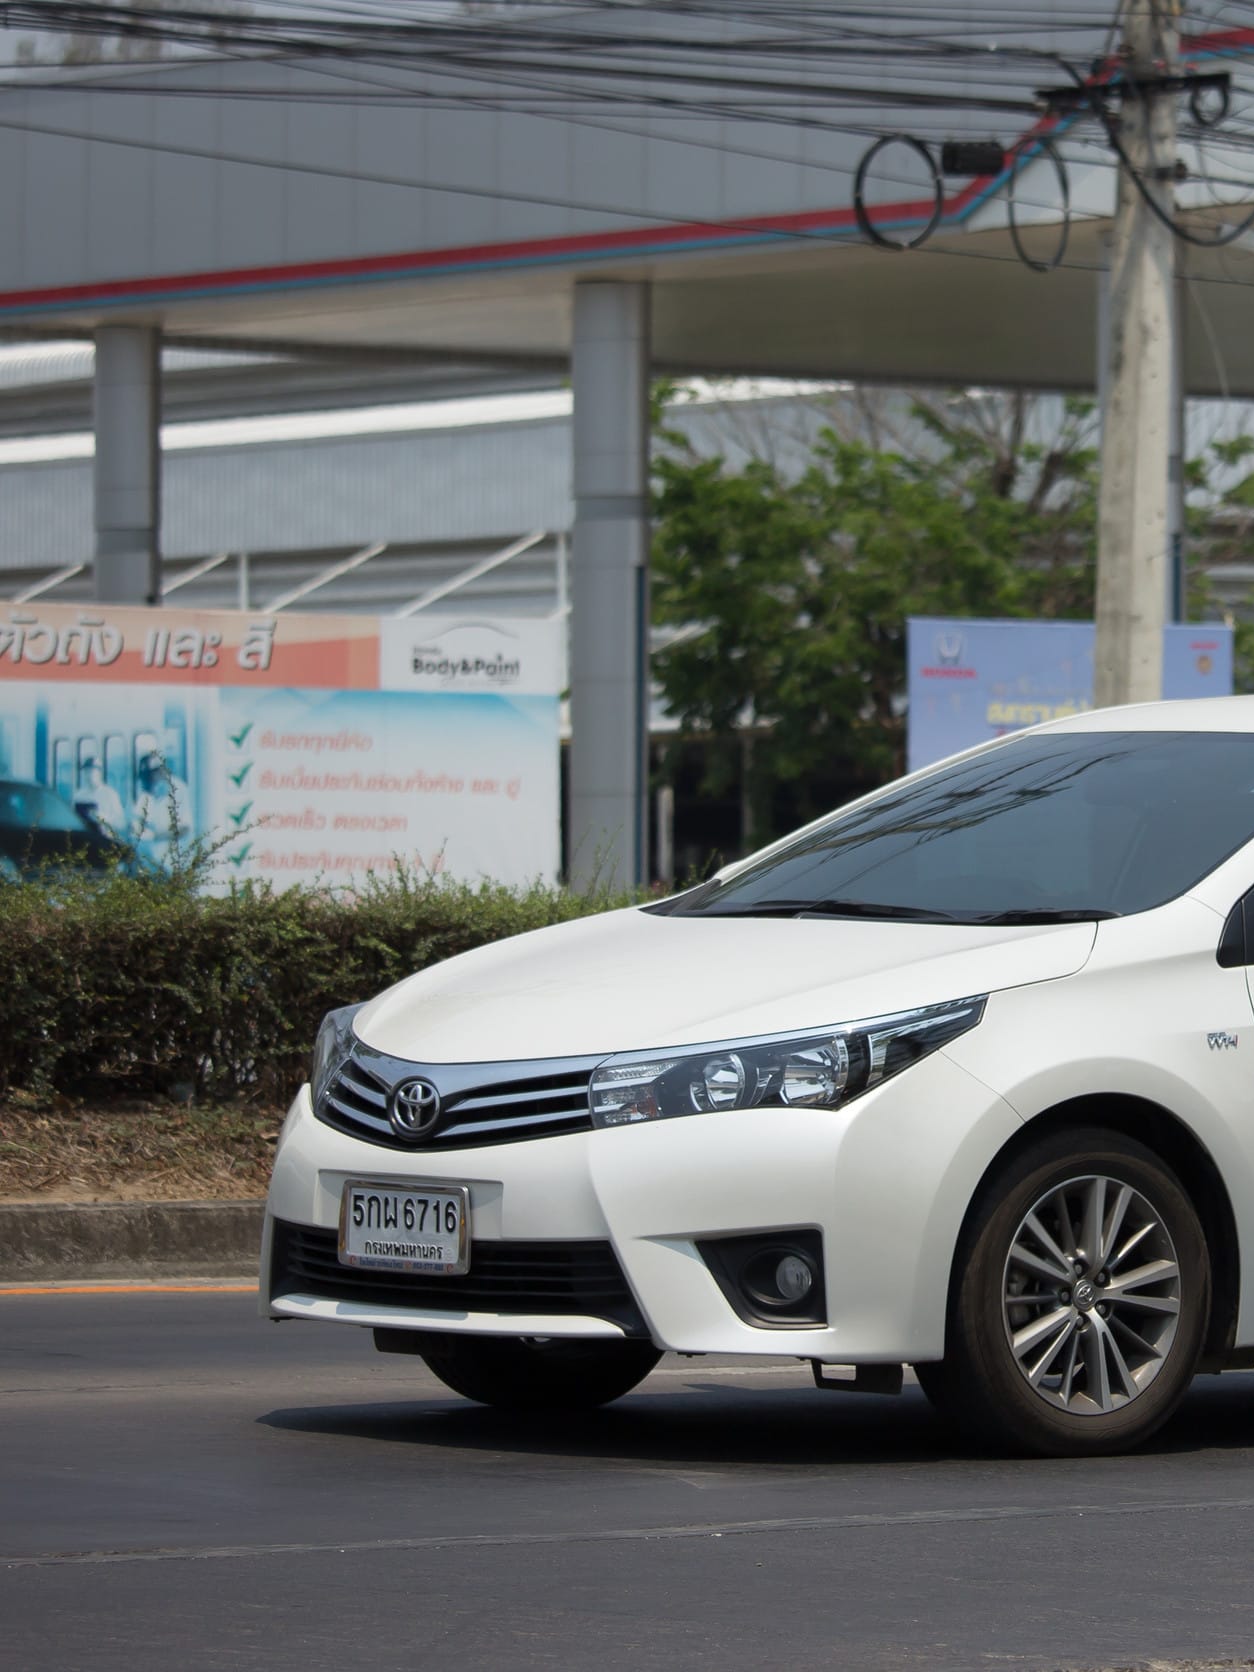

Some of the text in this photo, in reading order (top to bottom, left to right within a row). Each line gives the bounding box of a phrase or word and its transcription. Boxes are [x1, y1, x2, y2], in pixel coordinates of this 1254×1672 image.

[143, 625, 222, 669] และ
[237, 617, 277, 671] สี
[412, 653, 521, 680] Body&Paint
[404, 1198, 457, 1233] 6716
